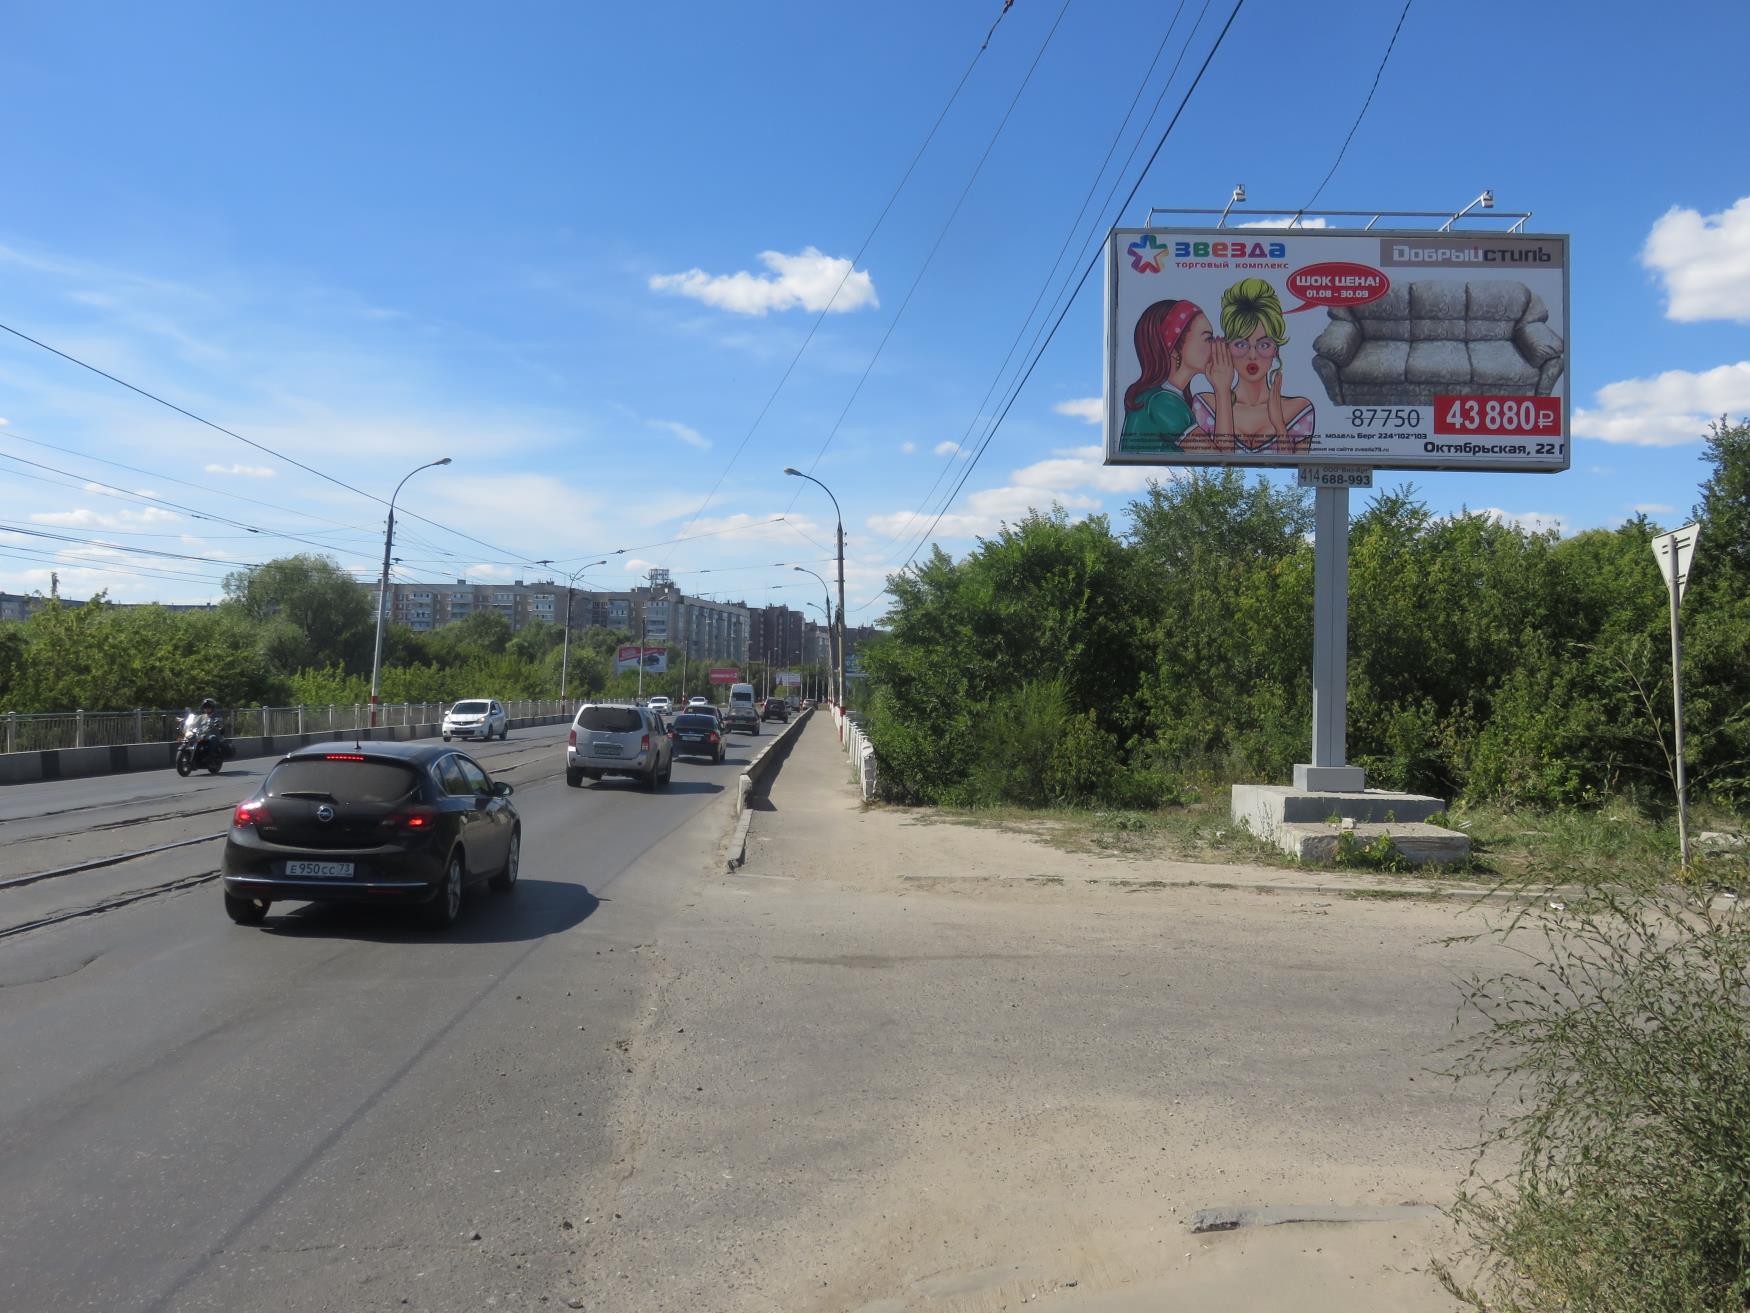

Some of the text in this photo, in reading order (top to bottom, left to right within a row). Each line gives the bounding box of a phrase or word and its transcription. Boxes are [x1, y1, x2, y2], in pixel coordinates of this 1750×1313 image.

[1175, 261, 1289, 270] торговый комплекс
[1296, 275, 1380, 288] ШОК ЦЕНА!
[1306, 290, 1332, 298] 01.08
[1340, 290, 1369, 298] 30.09
[1351, 408, 1420, 428] 87750
[1423, 441, 1531, 456] Октябрьская,
[1535, 443, 1555, 455] 22
[1321, 474, 1371, 485] 688-993
